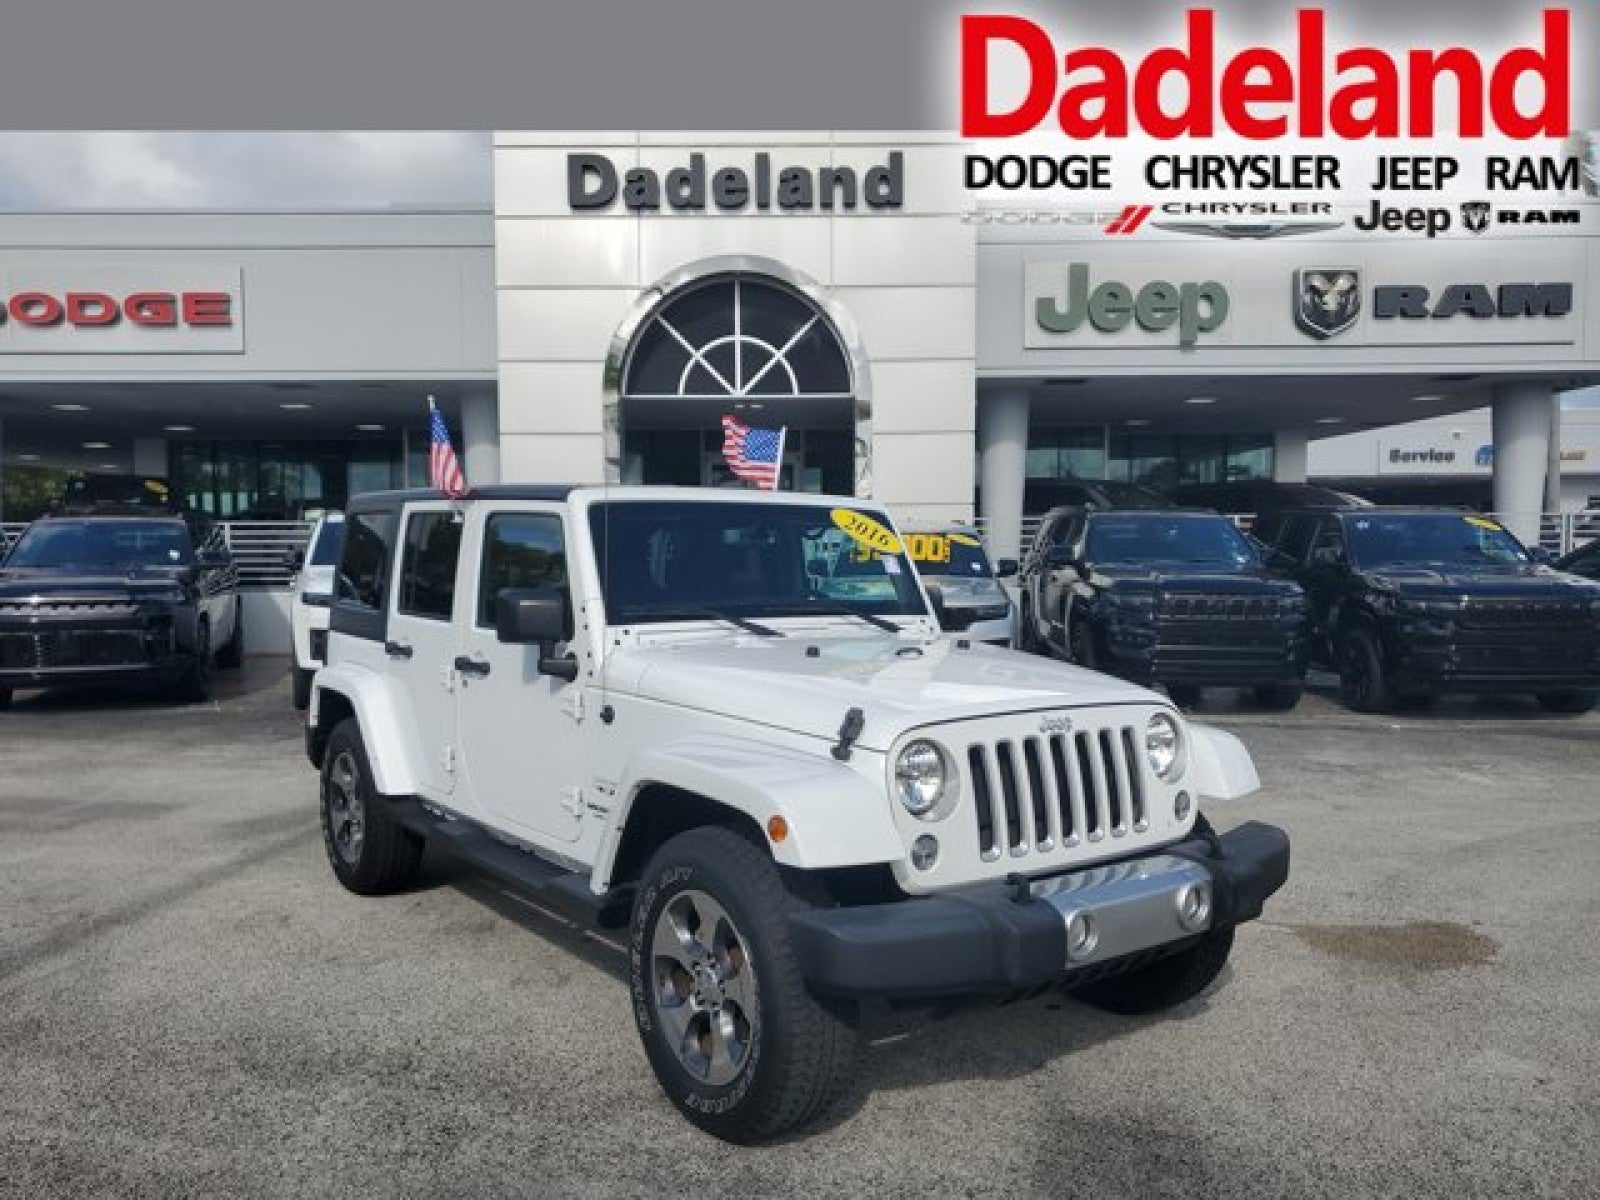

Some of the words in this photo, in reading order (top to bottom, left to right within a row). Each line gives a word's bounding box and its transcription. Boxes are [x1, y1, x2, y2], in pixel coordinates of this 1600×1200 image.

[567, 152, 905, 211] Dadeland
[0, 291, 234, 328] ODGE
[1035, 262, 1230, 351] Jeep
[1373, 281, 1574, 319] RAM
[1389, 447, 1456, 463] Service
